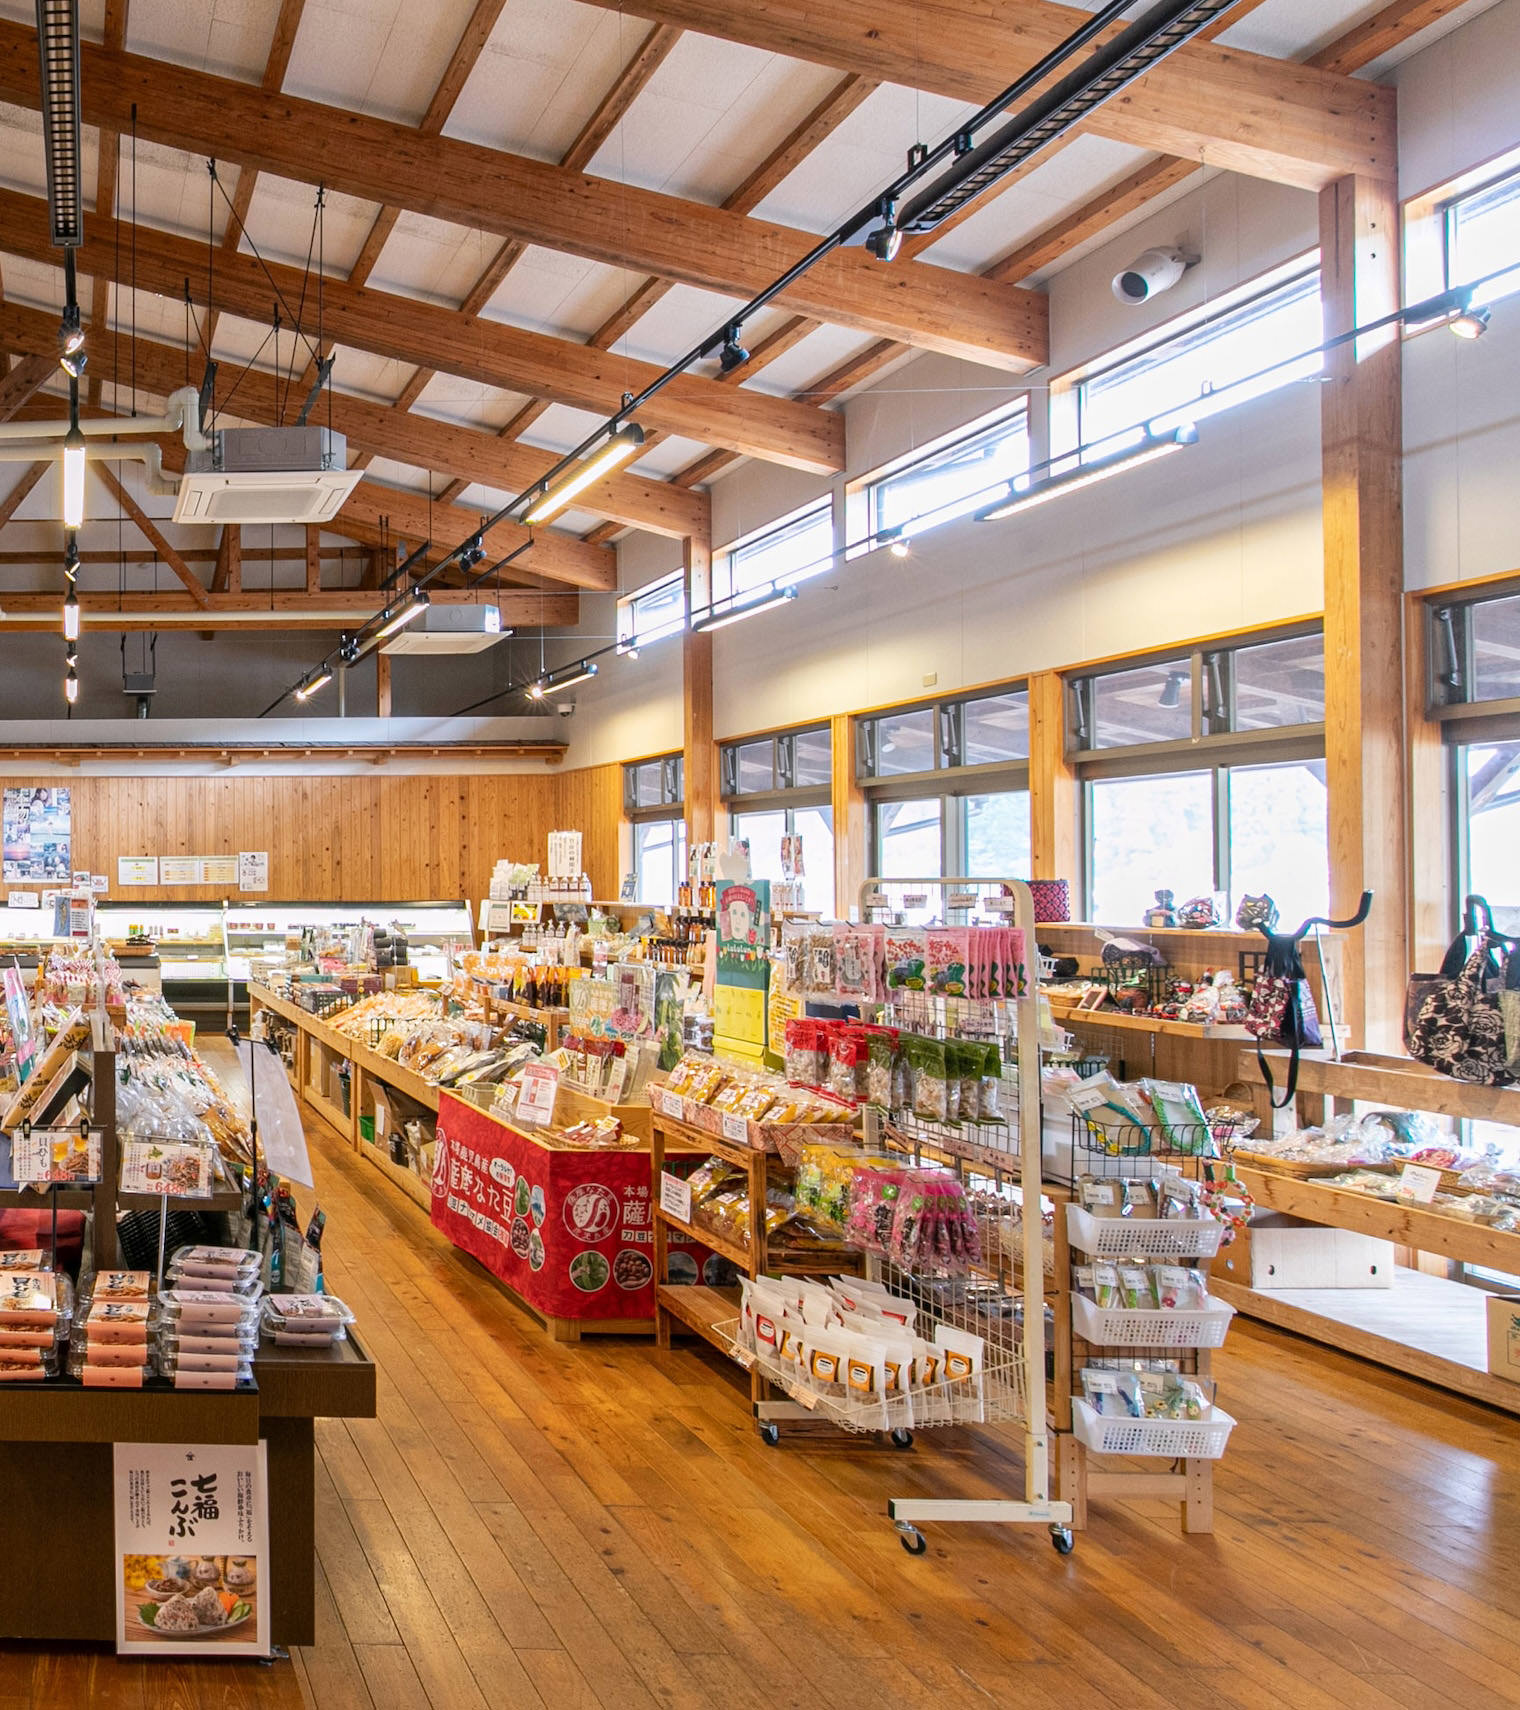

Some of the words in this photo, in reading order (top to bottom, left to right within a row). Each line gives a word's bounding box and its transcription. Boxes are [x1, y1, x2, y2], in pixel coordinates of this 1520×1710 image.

[623, 1185, 649, 1198] 本場
[623, 1201, 653, 1225] 薩
[169, 1478, 199, 1538] こんぶ
[190, 1473, 220, 1520] 七福
